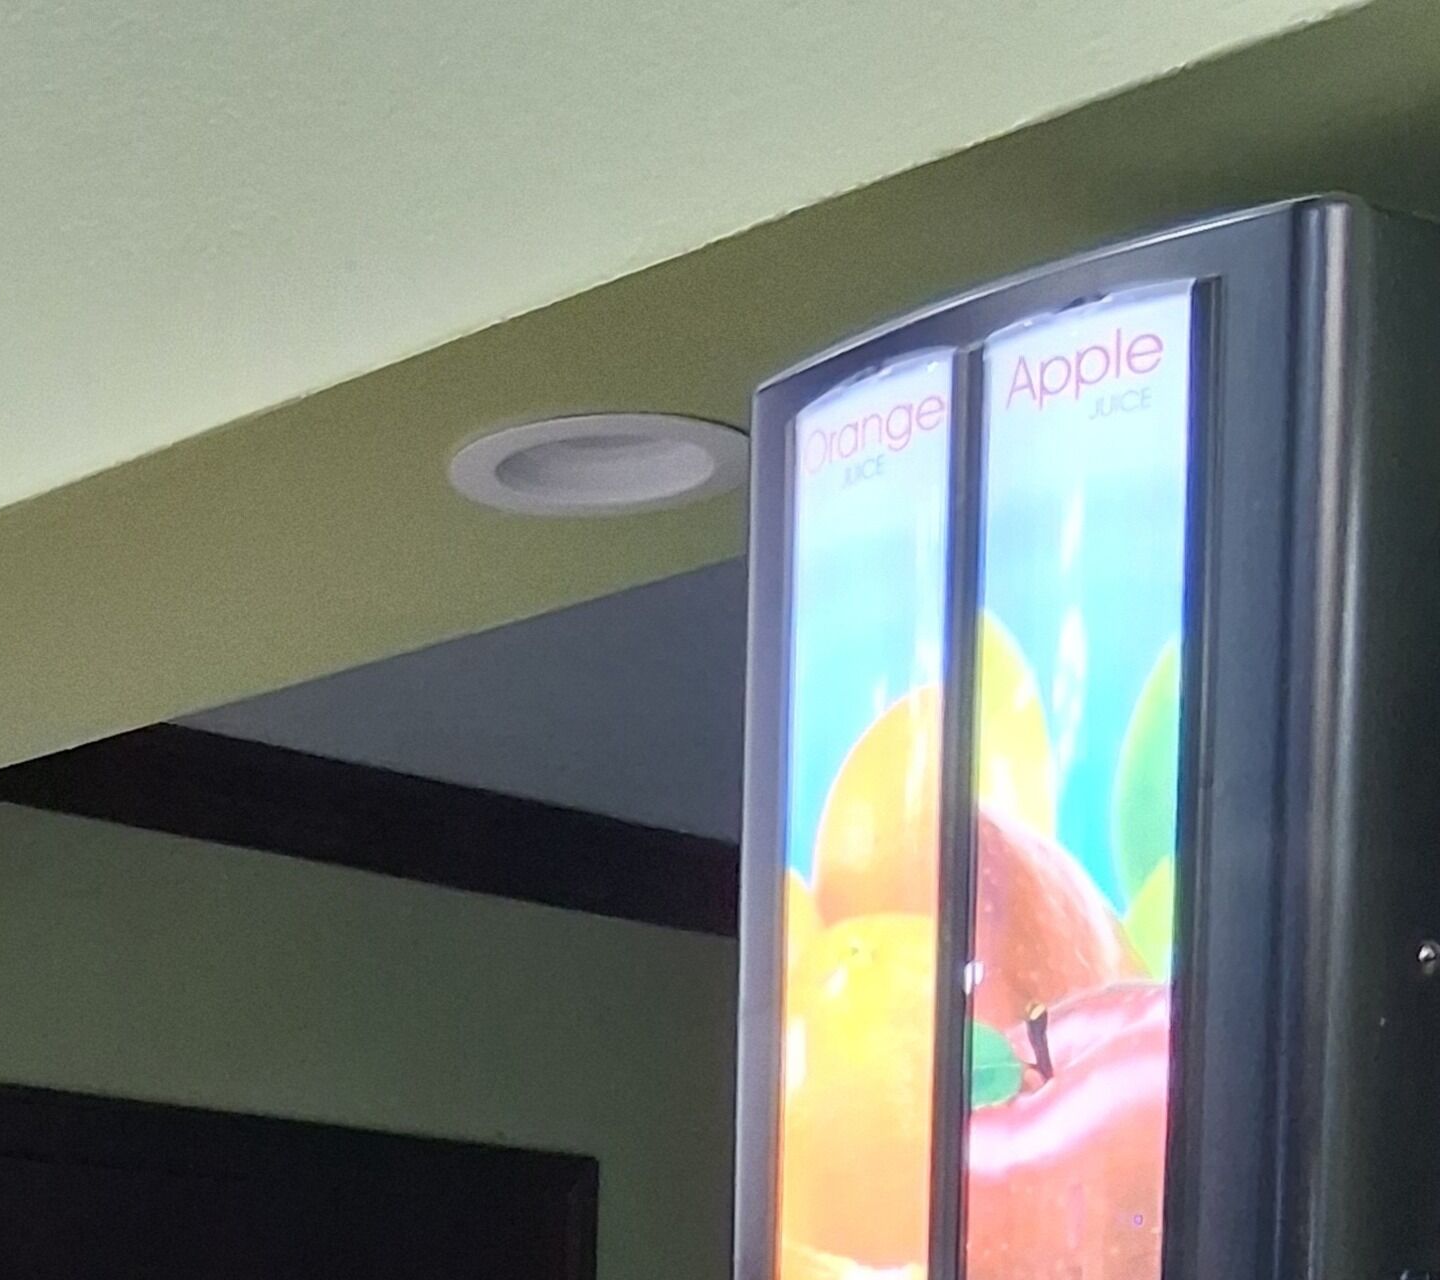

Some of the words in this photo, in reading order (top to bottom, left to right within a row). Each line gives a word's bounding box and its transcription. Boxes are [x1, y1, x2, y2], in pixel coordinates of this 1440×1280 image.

[1005, 327, 1164, 411] Apple
[1088, 386, 1152, 421] JUICE
[803, 394, 946, 475] Orange
